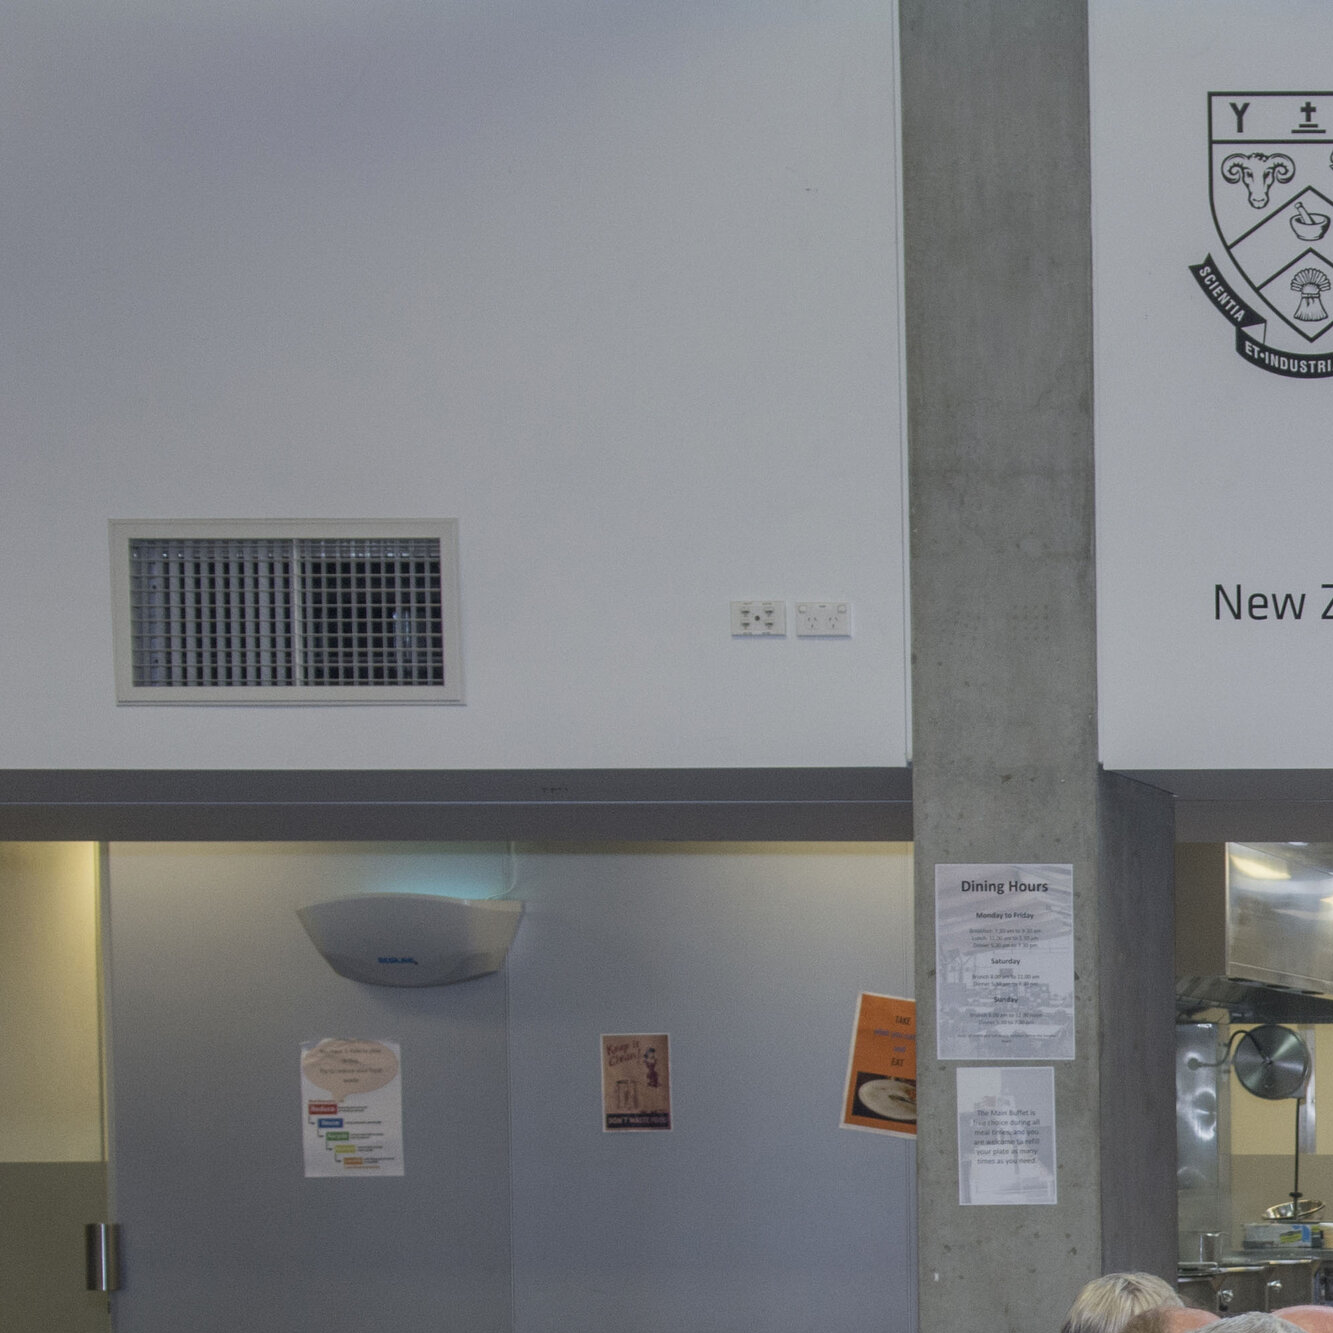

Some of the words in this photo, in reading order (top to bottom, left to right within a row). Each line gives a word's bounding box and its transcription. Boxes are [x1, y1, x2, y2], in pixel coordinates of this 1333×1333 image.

[1198, 264, 1247, 323] SCIENTIA
[1214, 583, 1306, 621] New
[961, 880, 1005, 895] Dining
[1009, 881, 1049, 892] Hours
[976, 912, 1003, 920] Monday
[1013, 912, 1034, 920] Friday
[895, 1016, 911, 1026] TAKE
[891, 1057, 904, 1066] EAT
